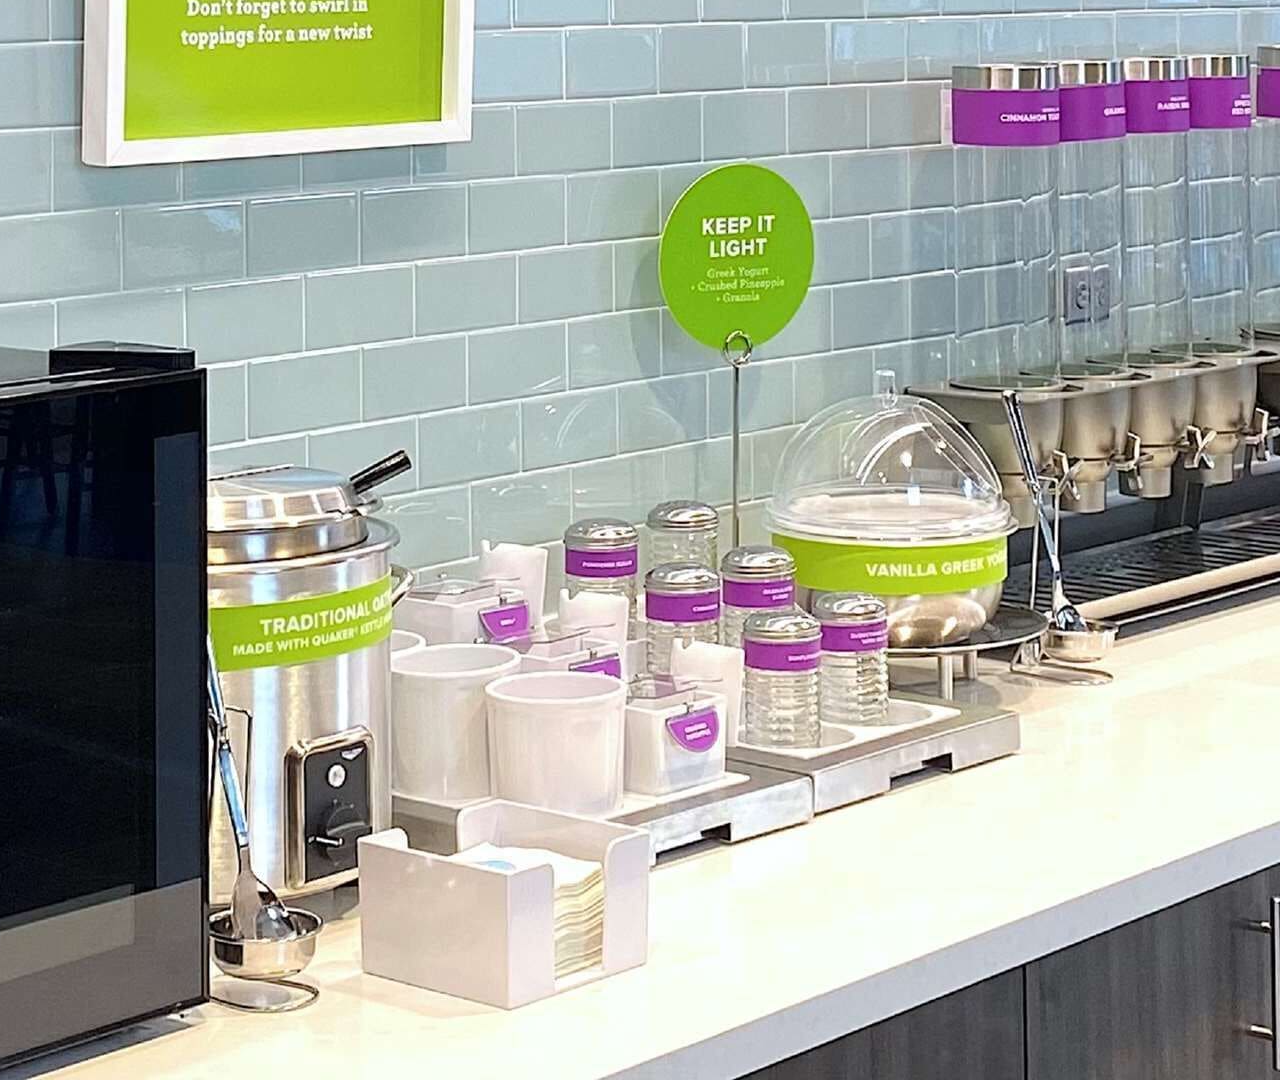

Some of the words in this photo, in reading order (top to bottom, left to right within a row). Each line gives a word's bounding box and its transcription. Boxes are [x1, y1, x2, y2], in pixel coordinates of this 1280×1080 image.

[181, 26, 255, 50] toppings
[257, 24, 283, 42] for
[285, 29, 297, 42] a
[298, 27, 331, 41] new
[333, 23, 374, 40] twist
[701, 216, 752, 236] KEEP
[757, 215, 776, 233] IT
[709, 237, 768, 259] LIGHT
[706, 267, 736, 280] Greek
[697, 279, 738, 293] Crushed
[739, 276, 785, 291] Pineapple
[722, 291, 760, 303] Granola
[865, 562, 938, 578] VANILLA
[941, 557, 985, 575] GREEK
[260, 600, 371, 637] TRADITIONAL
[232, 640, 274, 656] MADE
[275, 637, 310, 653] WITH
